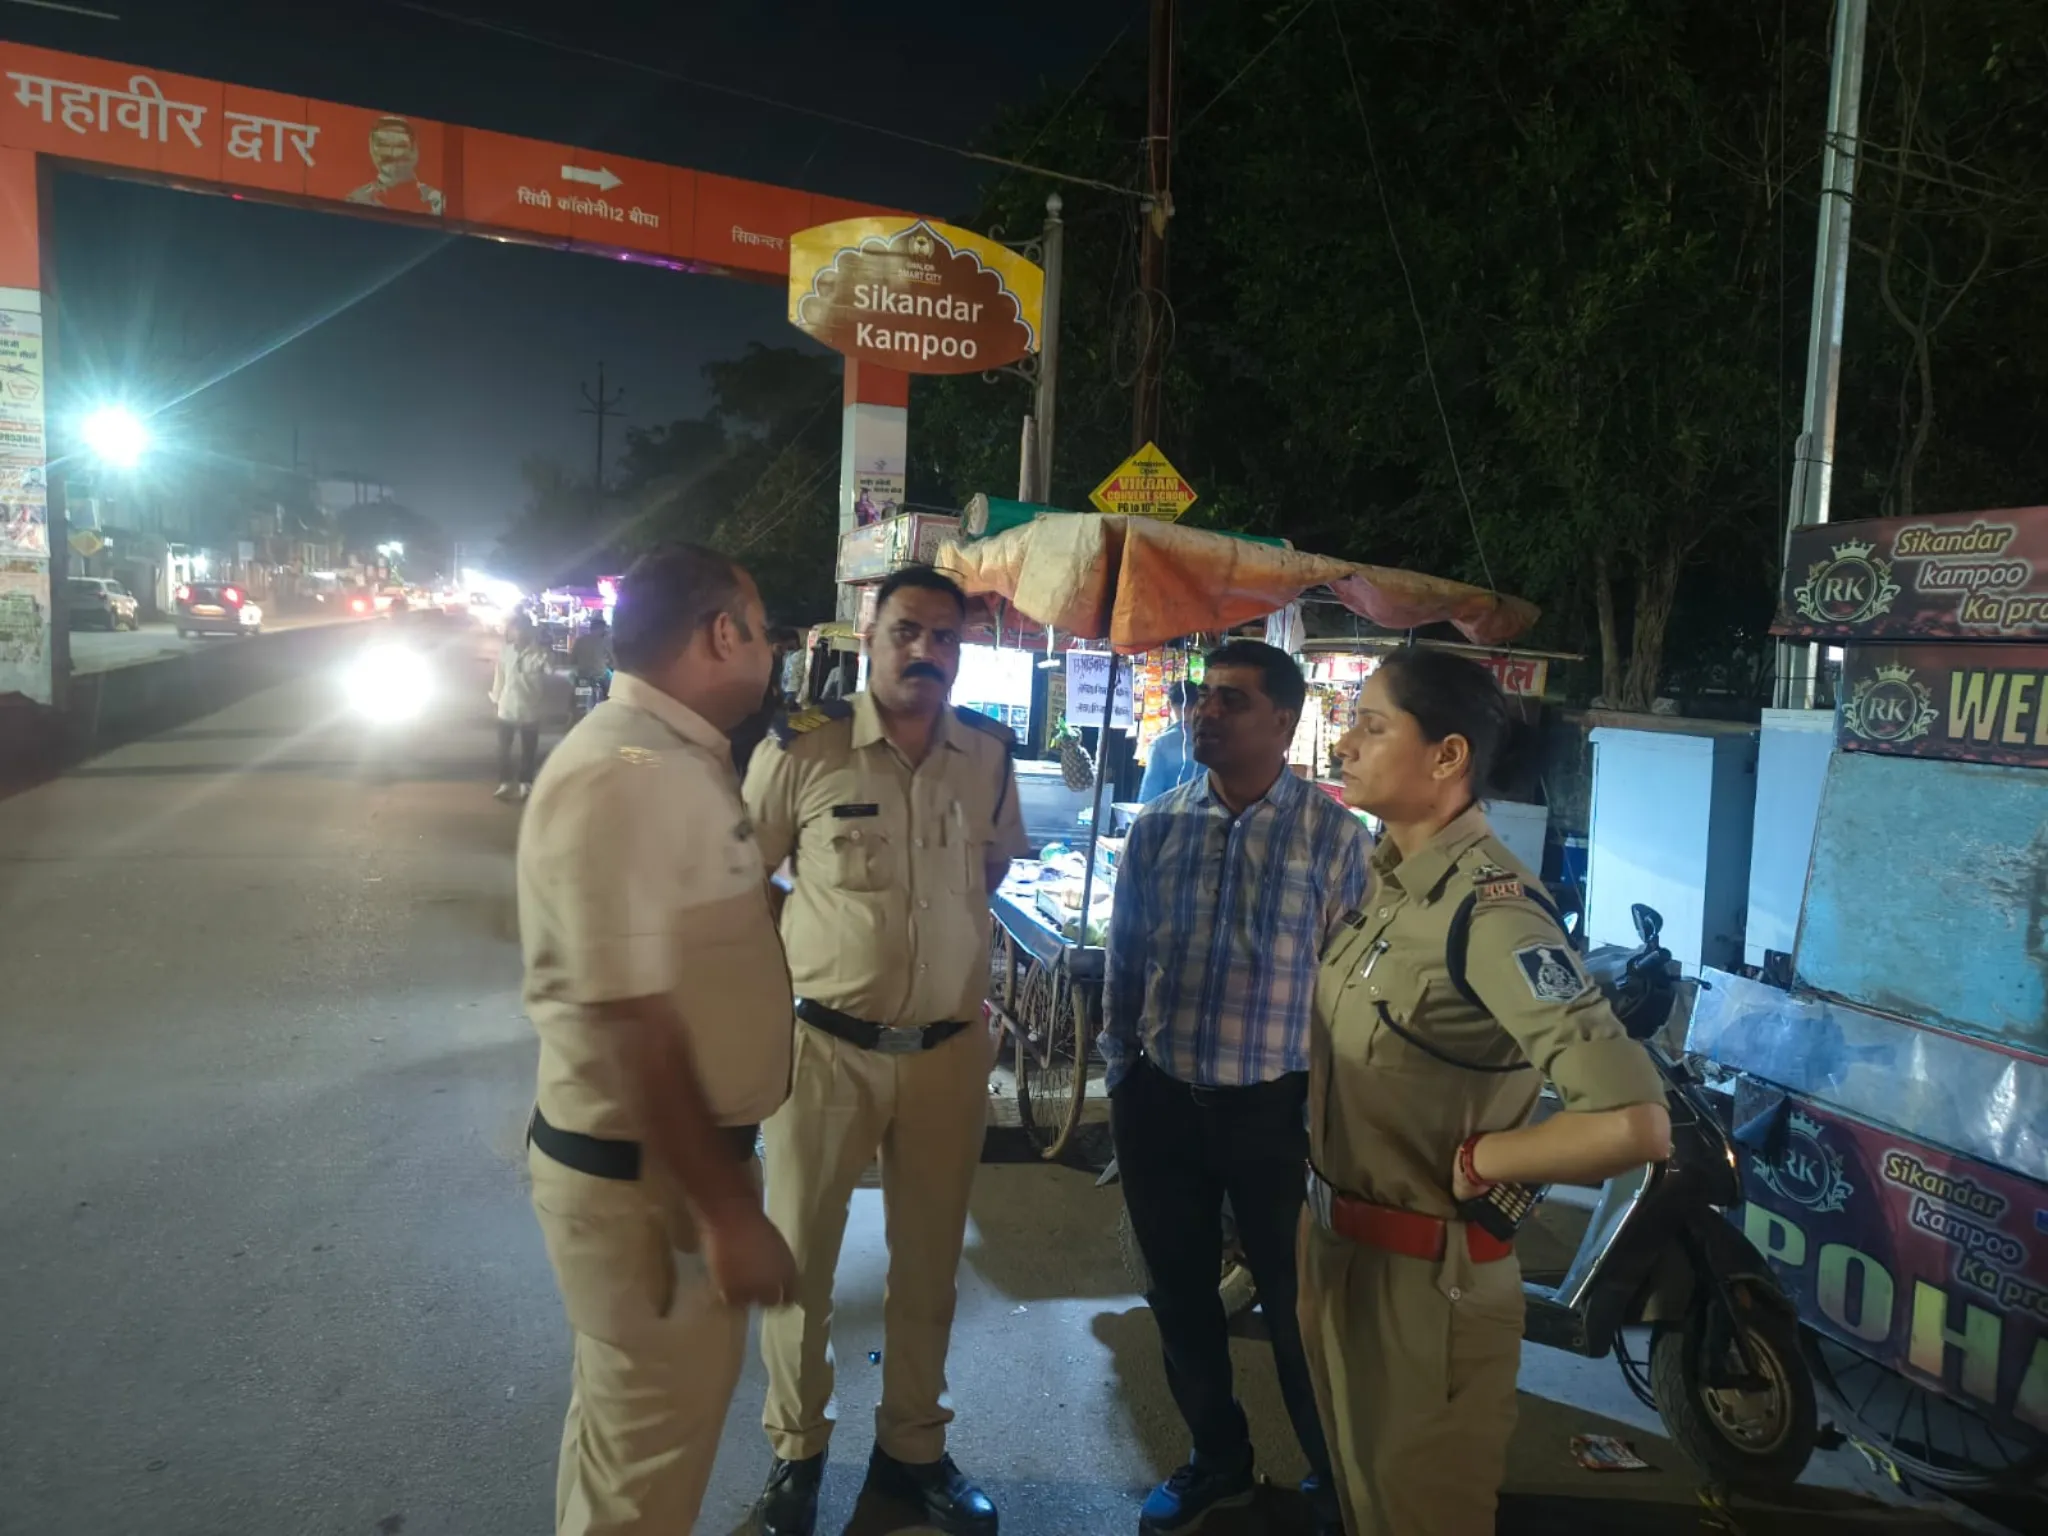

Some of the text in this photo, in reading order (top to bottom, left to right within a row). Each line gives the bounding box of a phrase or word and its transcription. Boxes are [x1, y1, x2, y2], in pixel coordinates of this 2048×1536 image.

[6, 72, 320, 167] महावीर द्वार
[853, 284, 984, 323] Sikandar
[856, 322, 978, 361] Kampoo
[1119, 478, 1178, 490] VIKRAM
[1898, 526, 2011, 555] Sikandar
[1823, 576, 1867, 602] RK
[1922, 564, 2024, 590] kampoo
[1964, 596, 1998, 621] Ka
[1869, 697, 1906, 722] RK
[1887, 1154, 2001, 1217] Sikandar
[1916, 1201, 2019, 1261] kampoo
[1962, 1258, 1997, 1290] Ka
